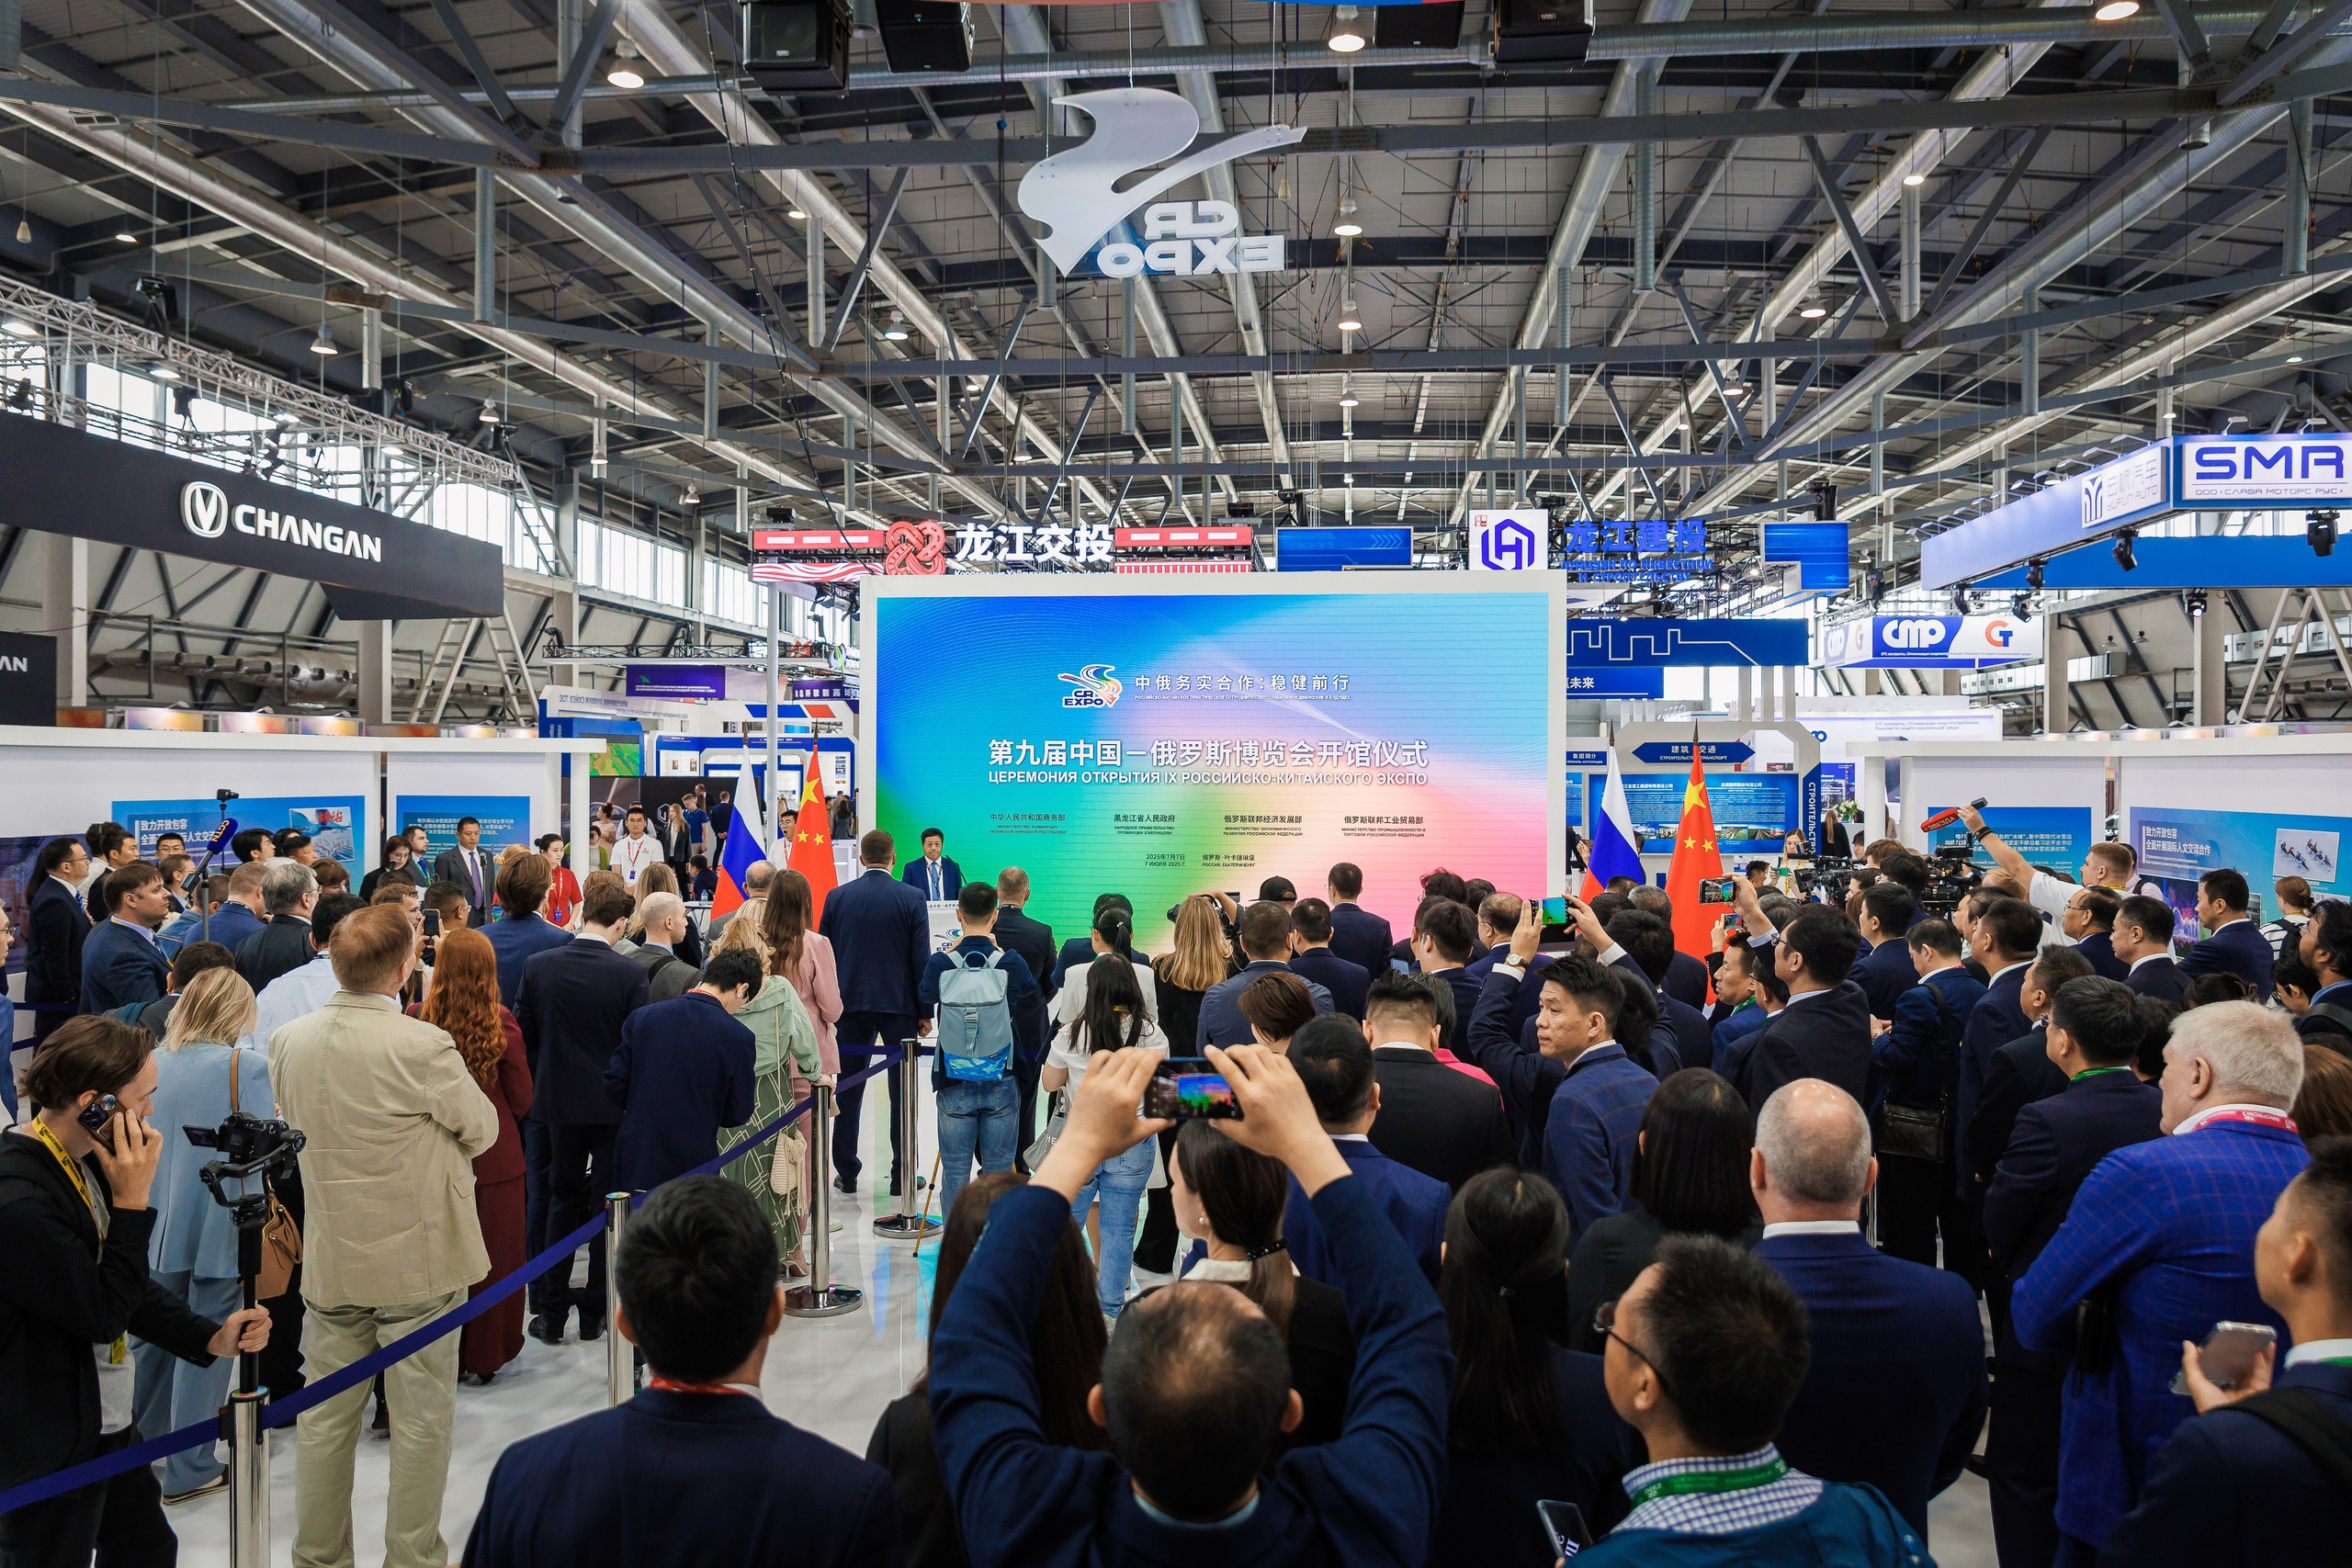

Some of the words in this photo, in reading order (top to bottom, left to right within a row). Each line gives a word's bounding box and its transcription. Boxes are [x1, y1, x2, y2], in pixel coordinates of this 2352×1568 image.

[2195, 446, 2344, 479] SMR
[232, 503, 381, 562] CHANGAN
[1564, 519, 1708, 553] 龙江建投
[955, 523, 1115, 563] 龙江交投
[1566, 676, 1595, 689] 未来
[1073, 690, 1094, 698] CR
[1064, 698, 1103, 706] EXPO
[989, 771, 1078, 784] ЦЕРЕМОНИЯ
[1081, 771, 1159, 784] ОТКРЫТИЯ
[1164, 772, 1178, 784] IX
[1182, 770, 1373, 785] РОССИЙСКО-КИТАЙСКОГО
[1377, 773, 1428, 785] ЭКСПО
[989, 813, 1067, 822] 中华人民共和国商务部
[1114, 814, 1176, 823] 黑龙江省人民政府
[1224, 815, 1303, 824] 俄罗斯联邦经济发展部
[1343, 816, 1424, 825] 俄罗斯联邦工业贸易部
[1928, 816, 1956, 831] ЗВЕЗДА
[210, 819, 230, 842] CGTN
